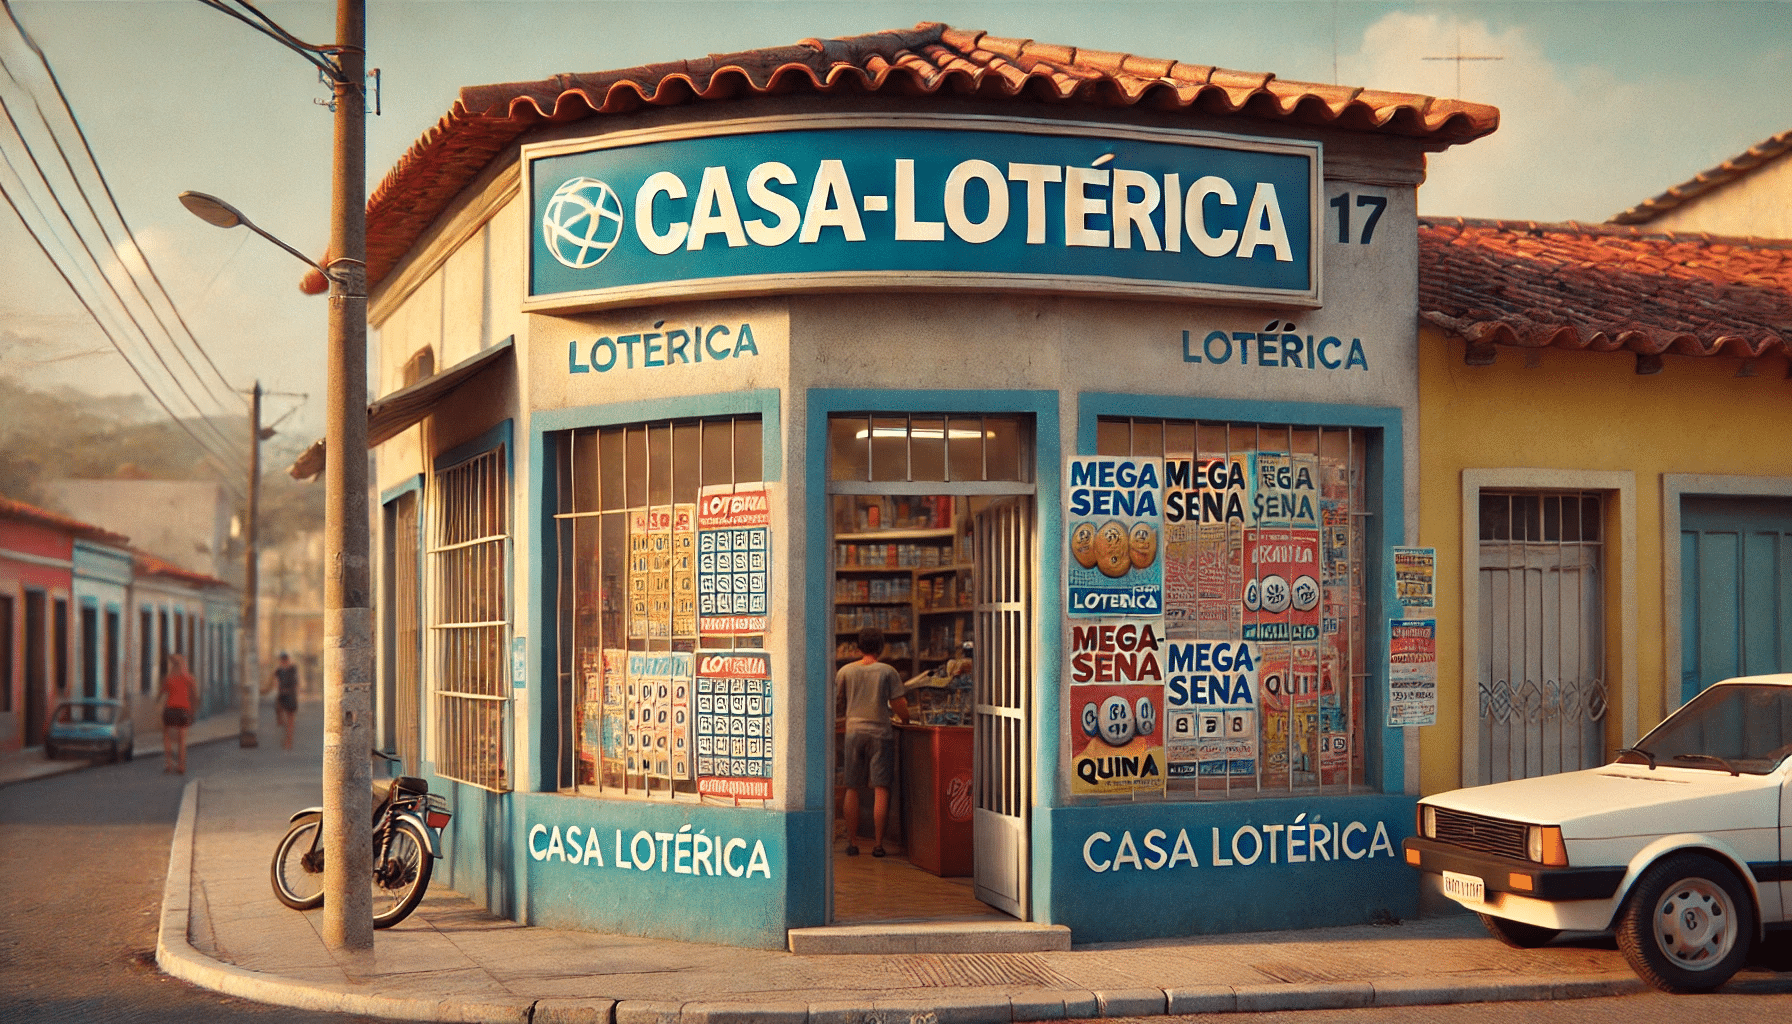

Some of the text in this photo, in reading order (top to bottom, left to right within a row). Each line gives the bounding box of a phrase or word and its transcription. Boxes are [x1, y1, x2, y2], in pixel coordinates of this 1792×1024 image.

[635, 153, 1294, 263] CASA-LOTÉRICA
[1330, 192, 1388, 245] 17
[568, 320, 759, 375] LOTÉRICA
[1071, 461, 1159, 489] MEGA
[1166, 460, 1246, 490] MEGA
[1069, 489, 1158, 517] SENA
[1166, 491, 1245, 524] SENA
[1252, 493, 1316, 522] SENA
[1071, 652, 1163, 683] SENA
[1168, 674, 1254, 706] SENA
[1077, 753, 1160, 786] QUINA
[528, 823, 604, 867] CASA
[1083, 812, 1395, 873] CASA LOTÉRICA
